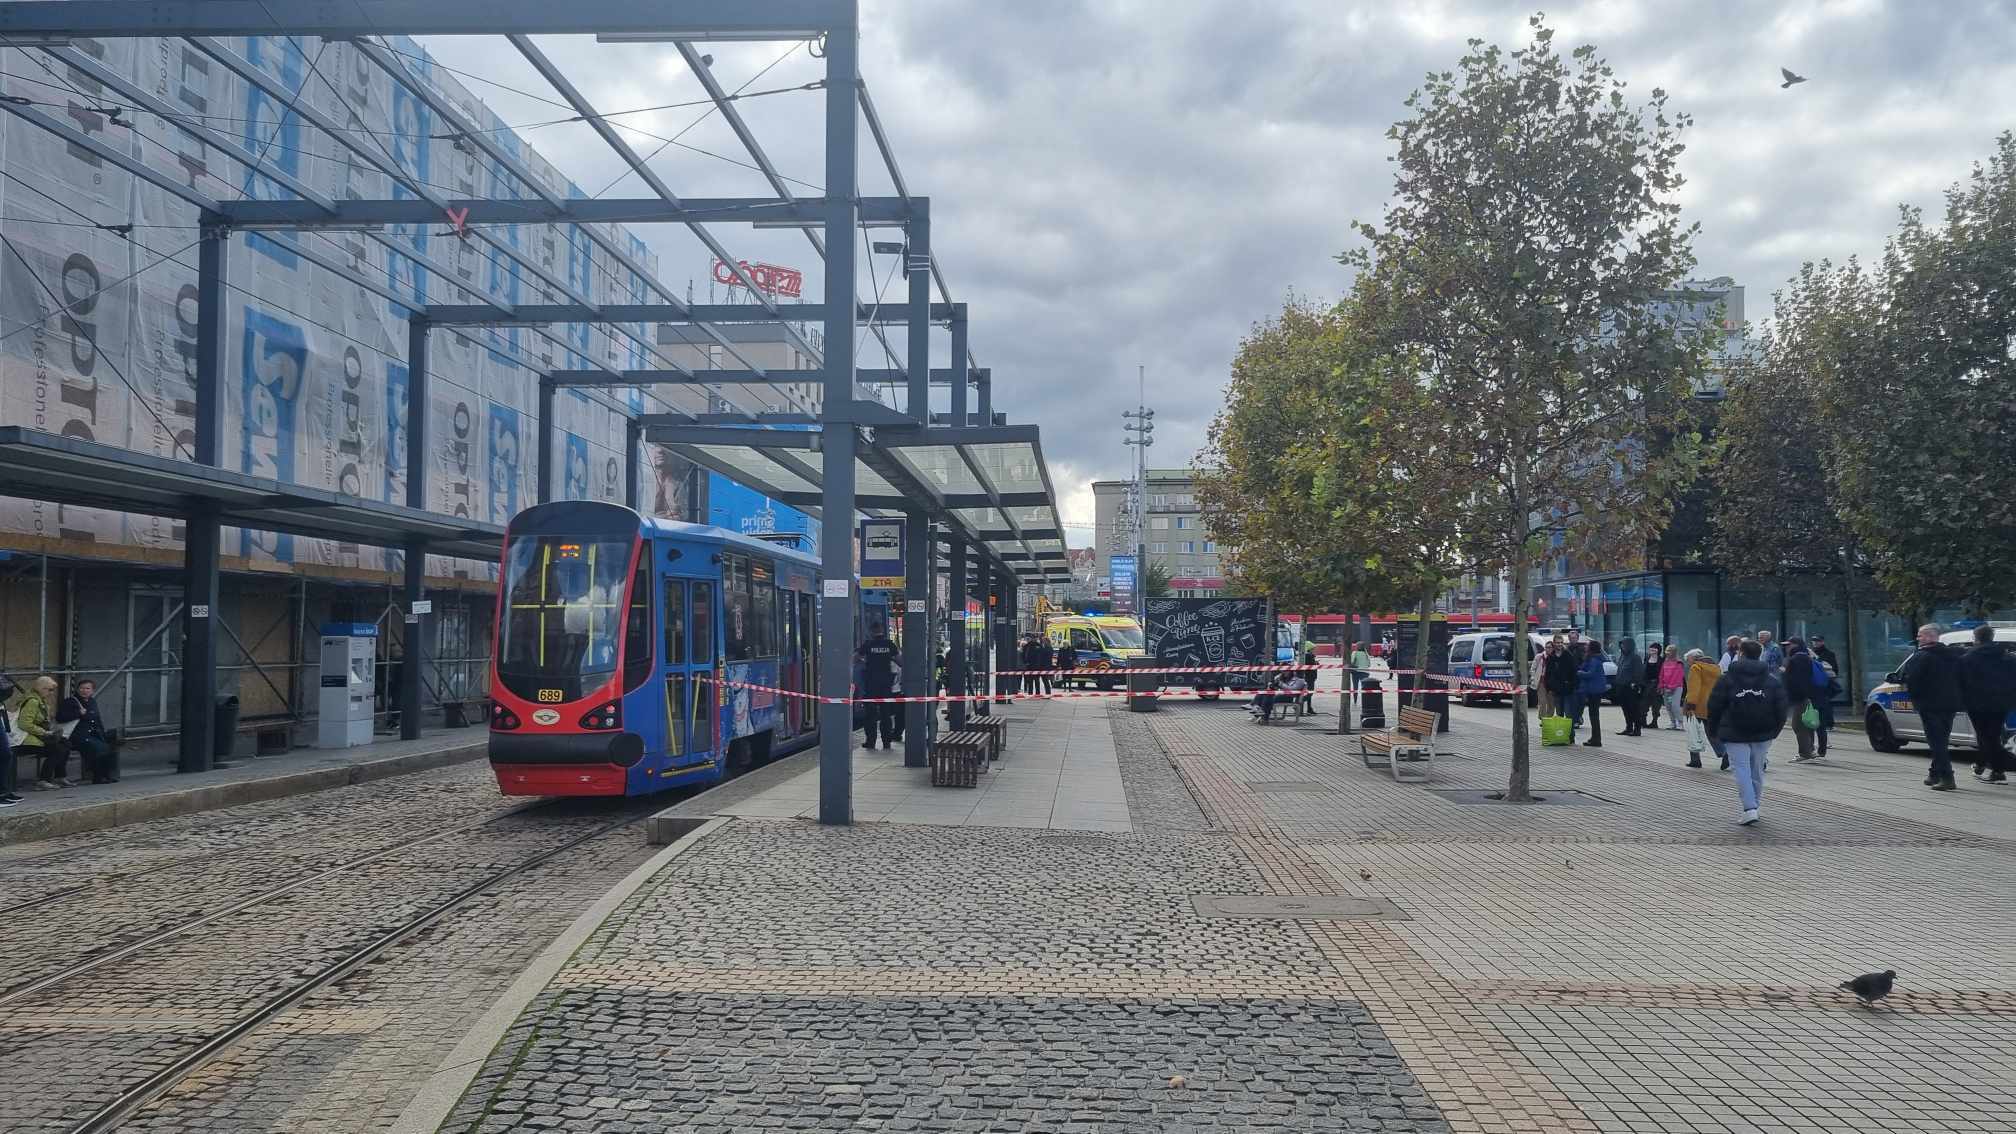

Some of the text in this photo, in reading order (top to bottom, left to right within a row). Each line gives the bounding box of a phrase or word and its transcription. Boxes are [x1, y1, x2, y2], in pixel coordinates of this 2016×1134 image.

[741, 514, 775, 529] prime
[1165, 610, 1199, 629] Coffee
[539, 690, 561, 701] 689
